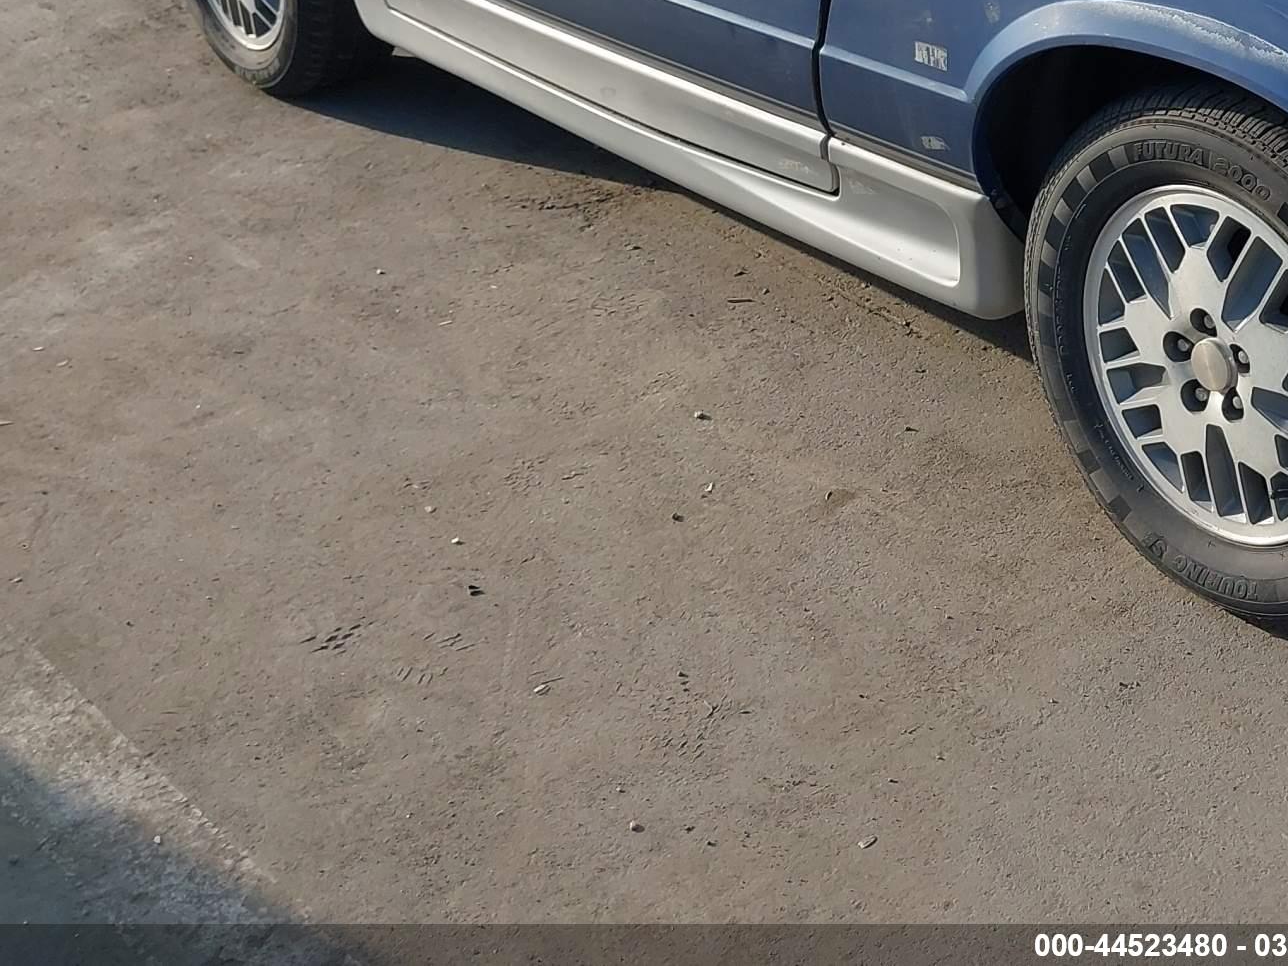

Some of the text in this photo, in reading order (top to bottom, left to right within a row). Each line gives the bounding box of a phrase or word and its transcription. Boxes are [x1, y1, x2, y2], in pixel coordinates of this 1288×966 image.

[1132, 139, 1272, 202] FUTURA 2000
[1172, 553, 1259, 601] TOURING
